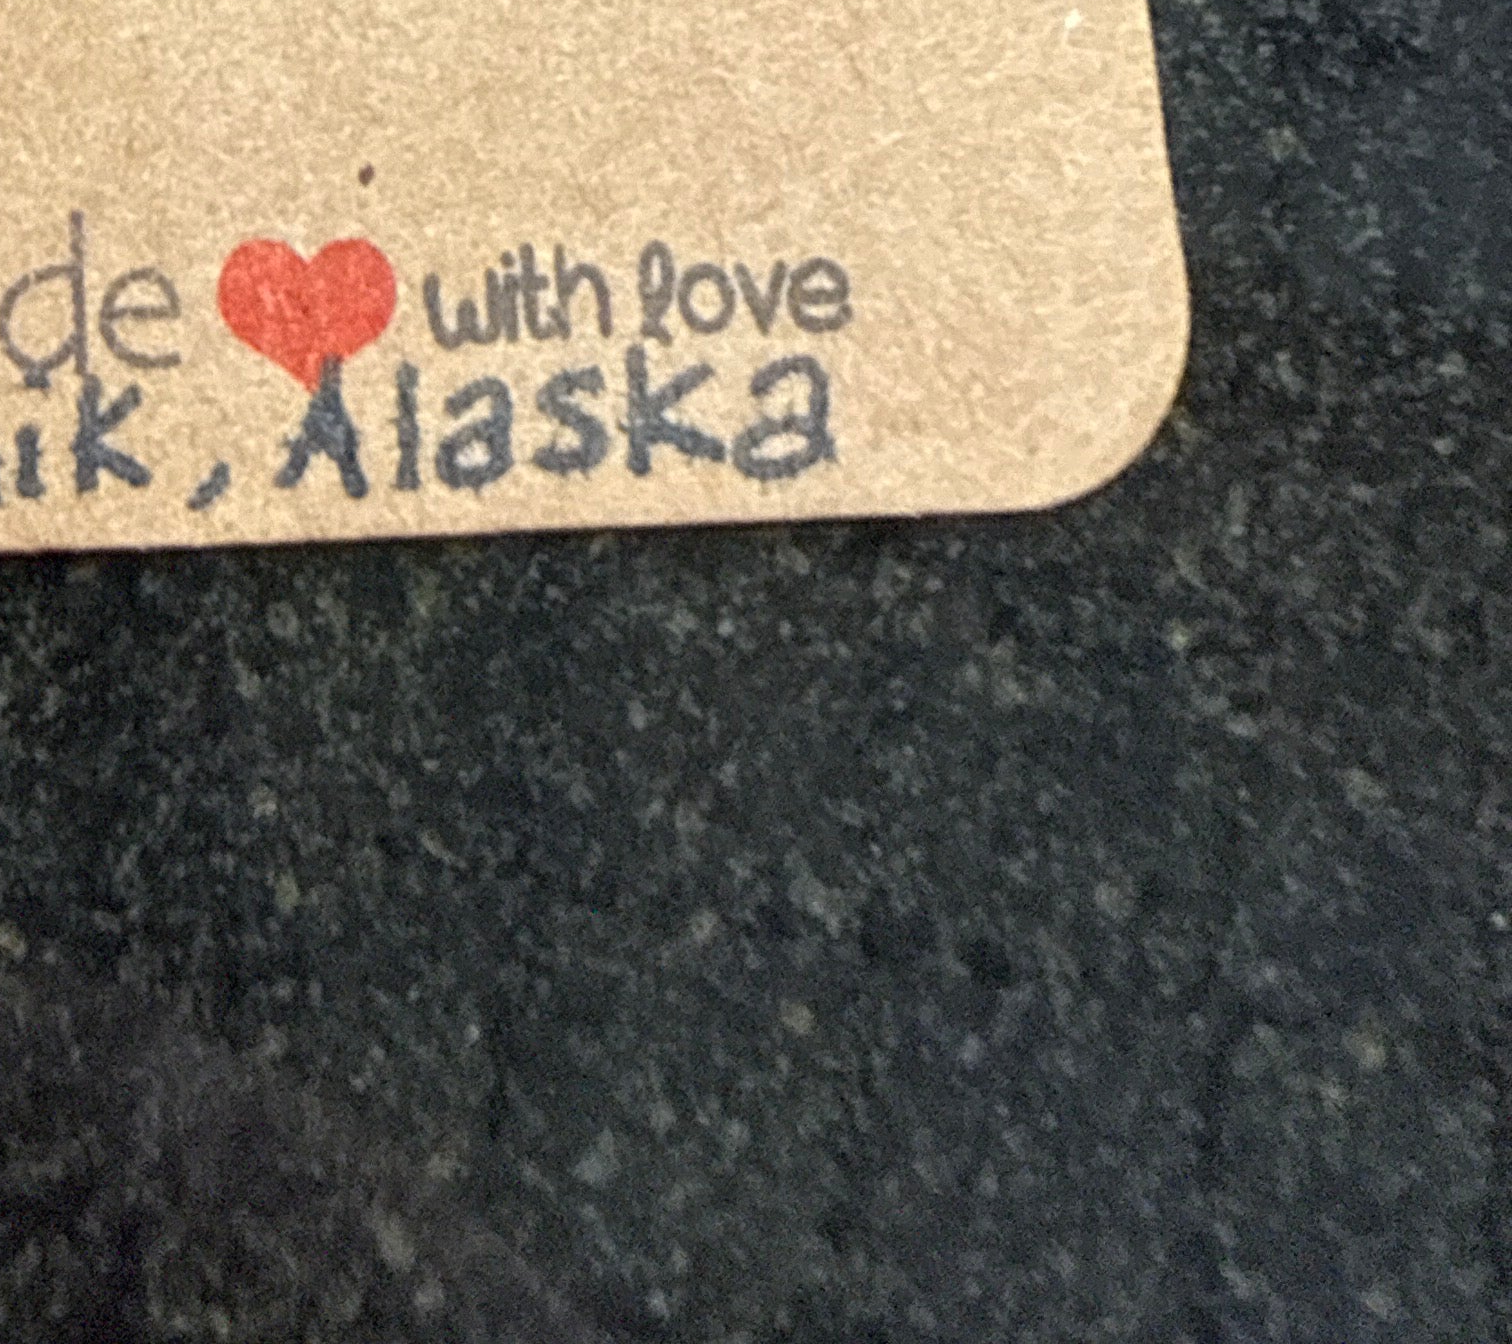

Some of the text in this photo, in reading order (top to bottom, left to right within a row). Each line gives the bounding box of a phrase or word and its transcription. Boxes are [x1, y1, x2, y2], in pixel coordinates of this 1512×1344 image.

[422, 240, 614, 352] with
[636, 239, 853, 347] love
[272, 343, 839, 501] Alaska
